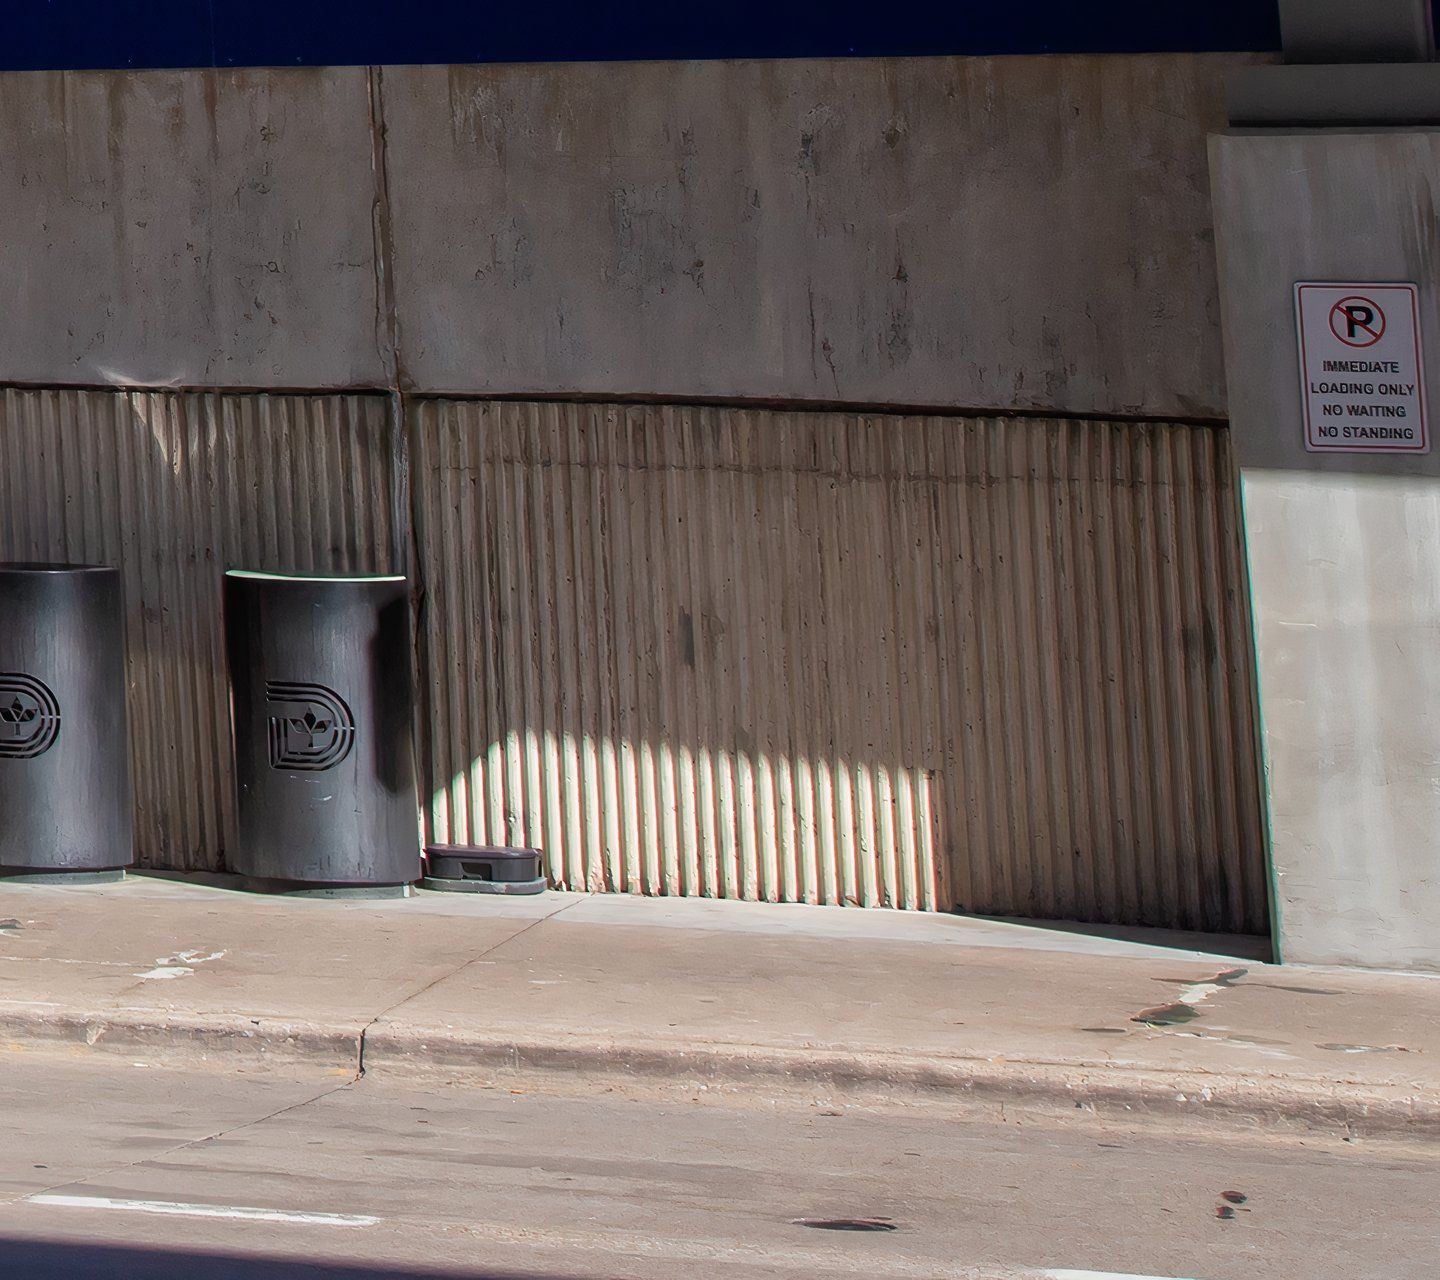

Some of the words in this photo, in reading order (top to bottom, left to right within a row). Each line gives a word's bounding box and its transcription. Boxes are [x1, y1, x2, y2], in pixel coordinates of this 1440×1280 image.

[1322, 360, 1400, 374] IMMEDIATE
[1310, 382, 1374, 395] LOADING
[1378, 383, 1415, 396] ONLY
[1322, 404, 1343, 416] NO
[1346, 404, 1407, 418] WAITING
[1318, 426, 1339, 438] NO
[1342, 426, 1414, 440] STANDING
